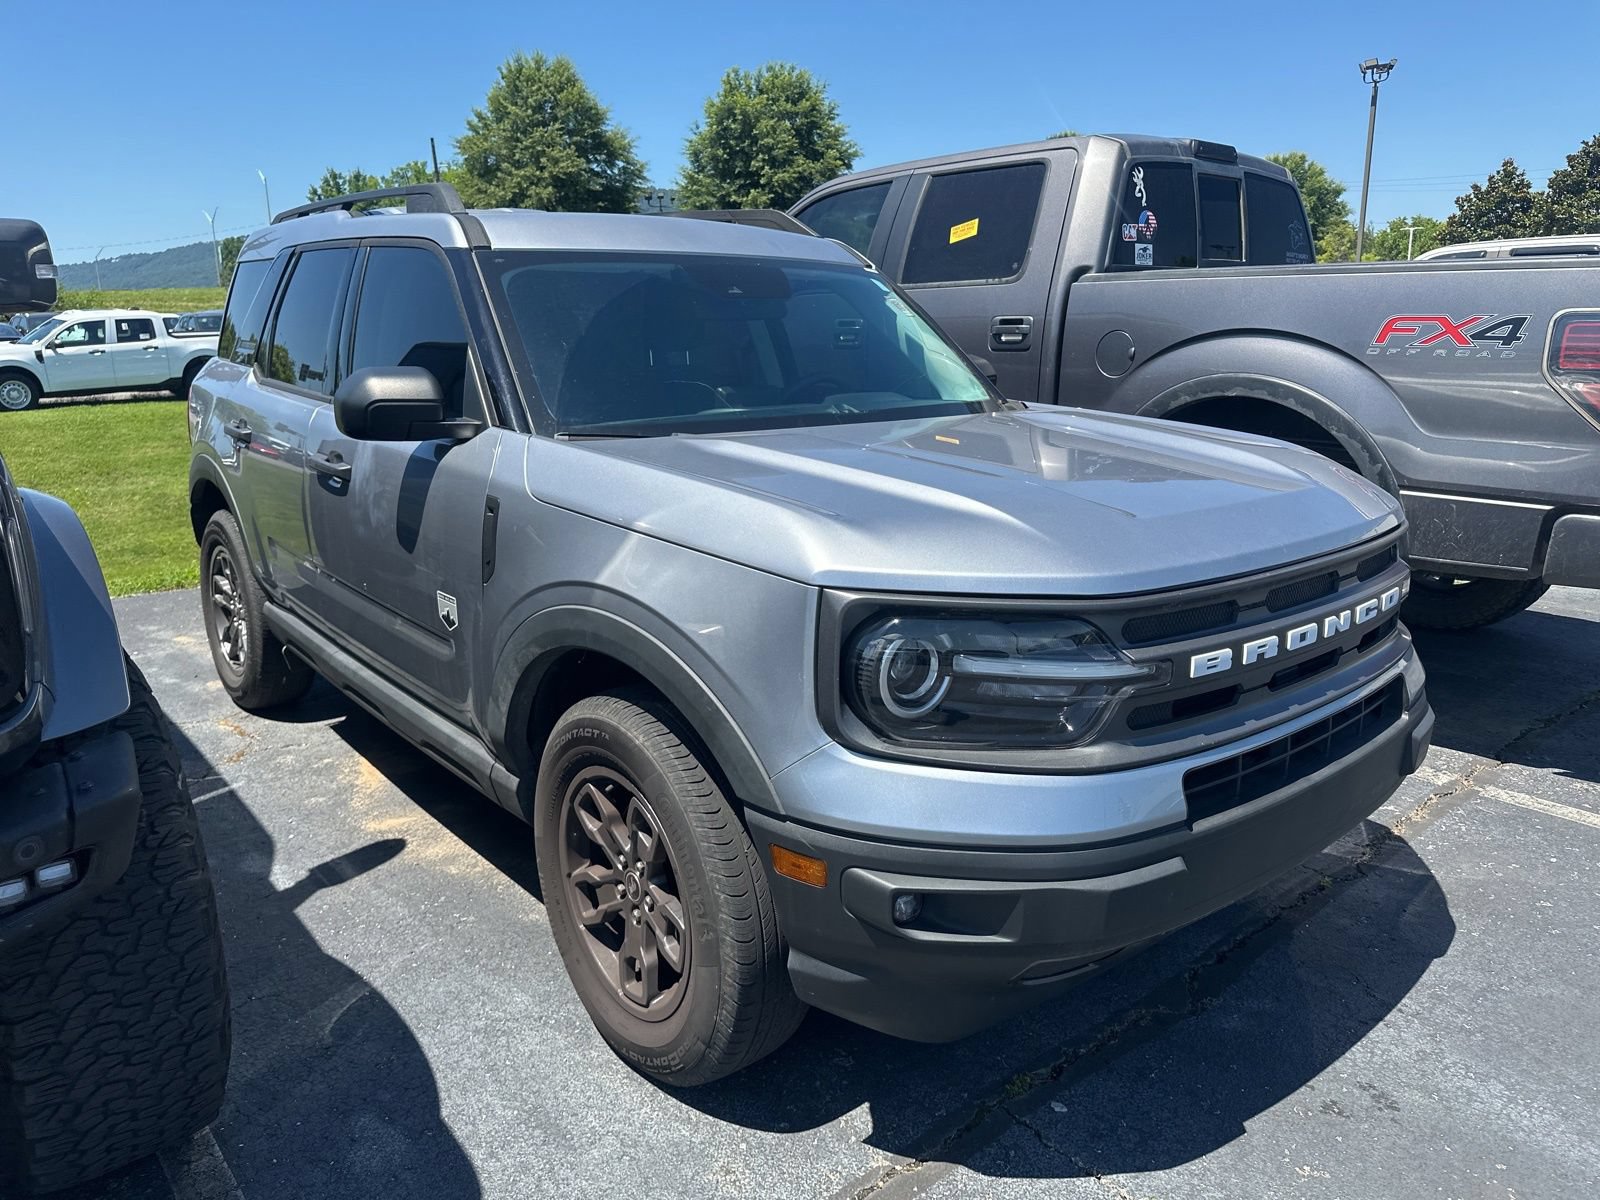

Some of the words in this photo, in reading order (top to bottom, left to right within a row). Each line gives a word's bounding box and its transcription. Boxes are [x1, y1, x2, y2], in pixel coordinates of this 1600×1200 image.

[1370, 314, 1533, 349] FX4
[1366, 348, 1421, 356] OFF
[1433, 349, 1516, 358] ROAD
[1190, 586, 1400, 678] BRONCO
